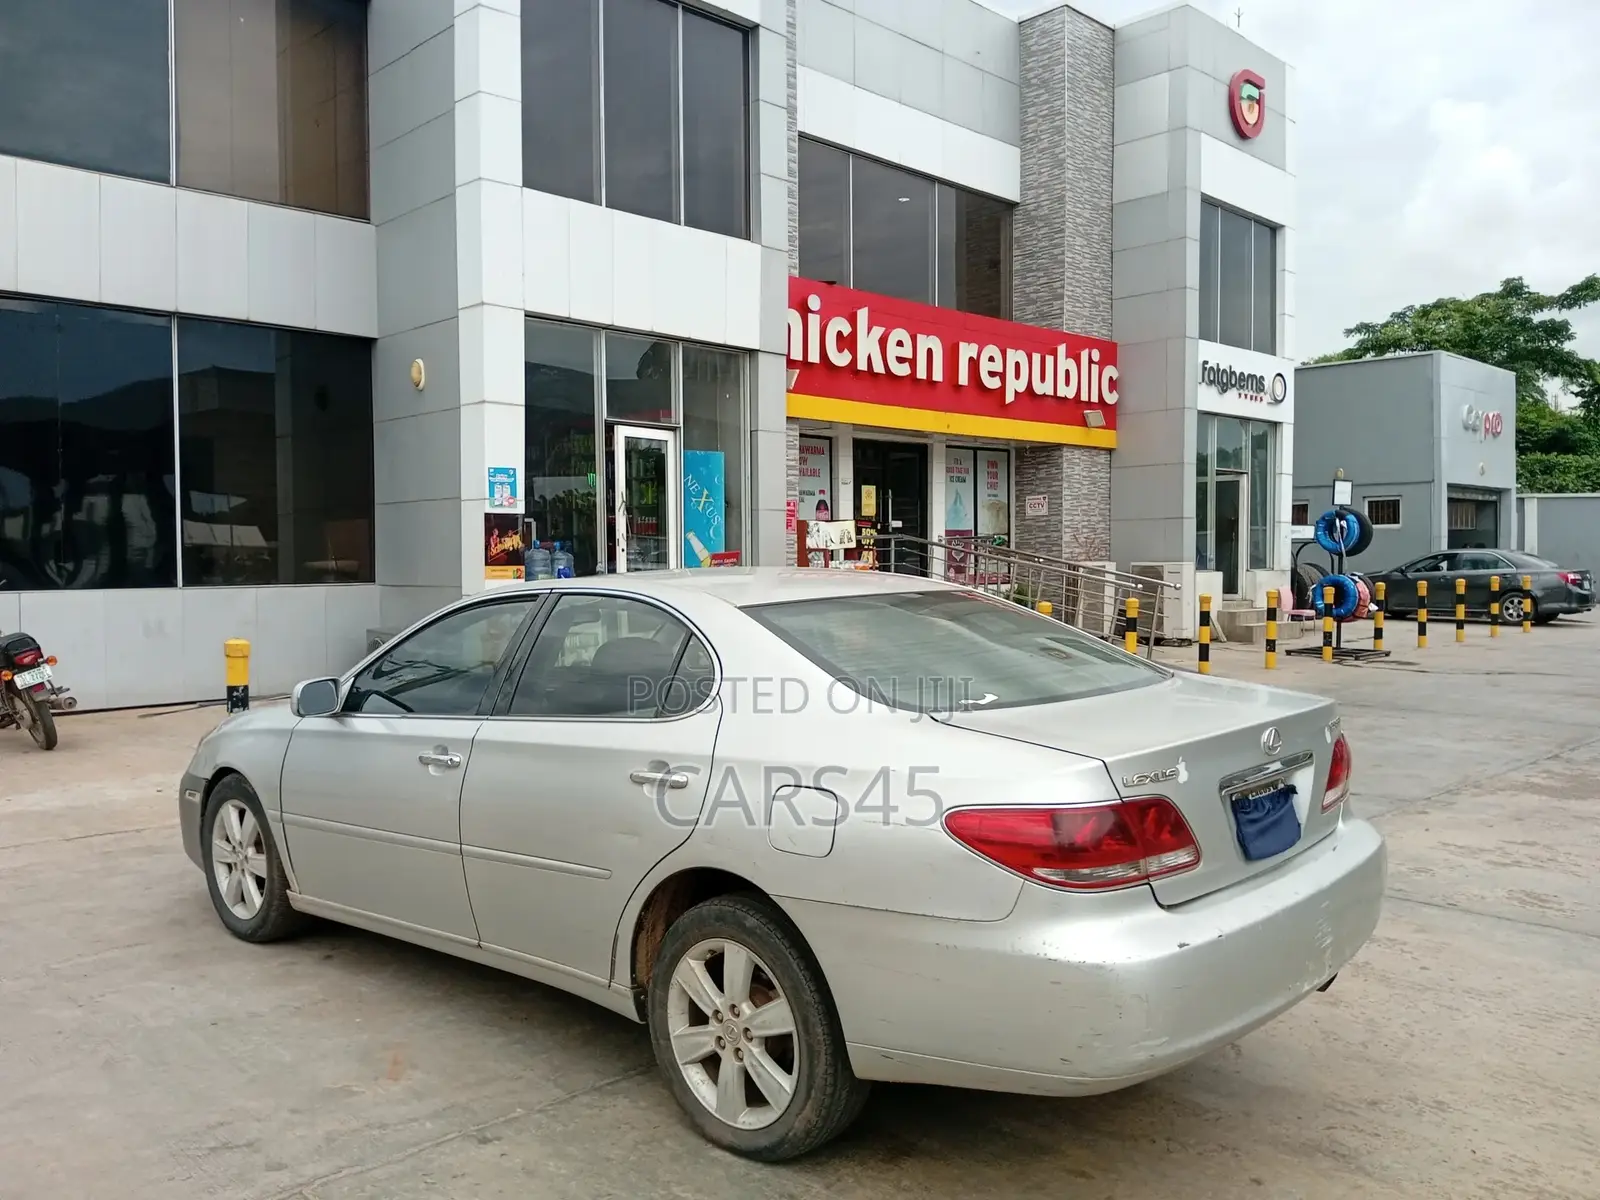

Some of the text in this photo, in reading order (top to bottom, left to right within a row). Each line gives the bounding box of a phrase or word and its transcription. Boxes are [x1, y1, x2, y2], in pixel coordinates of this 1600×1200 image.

[958, 341, 1119, 405] republic
[684, 473, 721, 526] NEXUS
[861, 527, 878, 536] 50%
[1121, 767, 1177, 787] LEXUS
